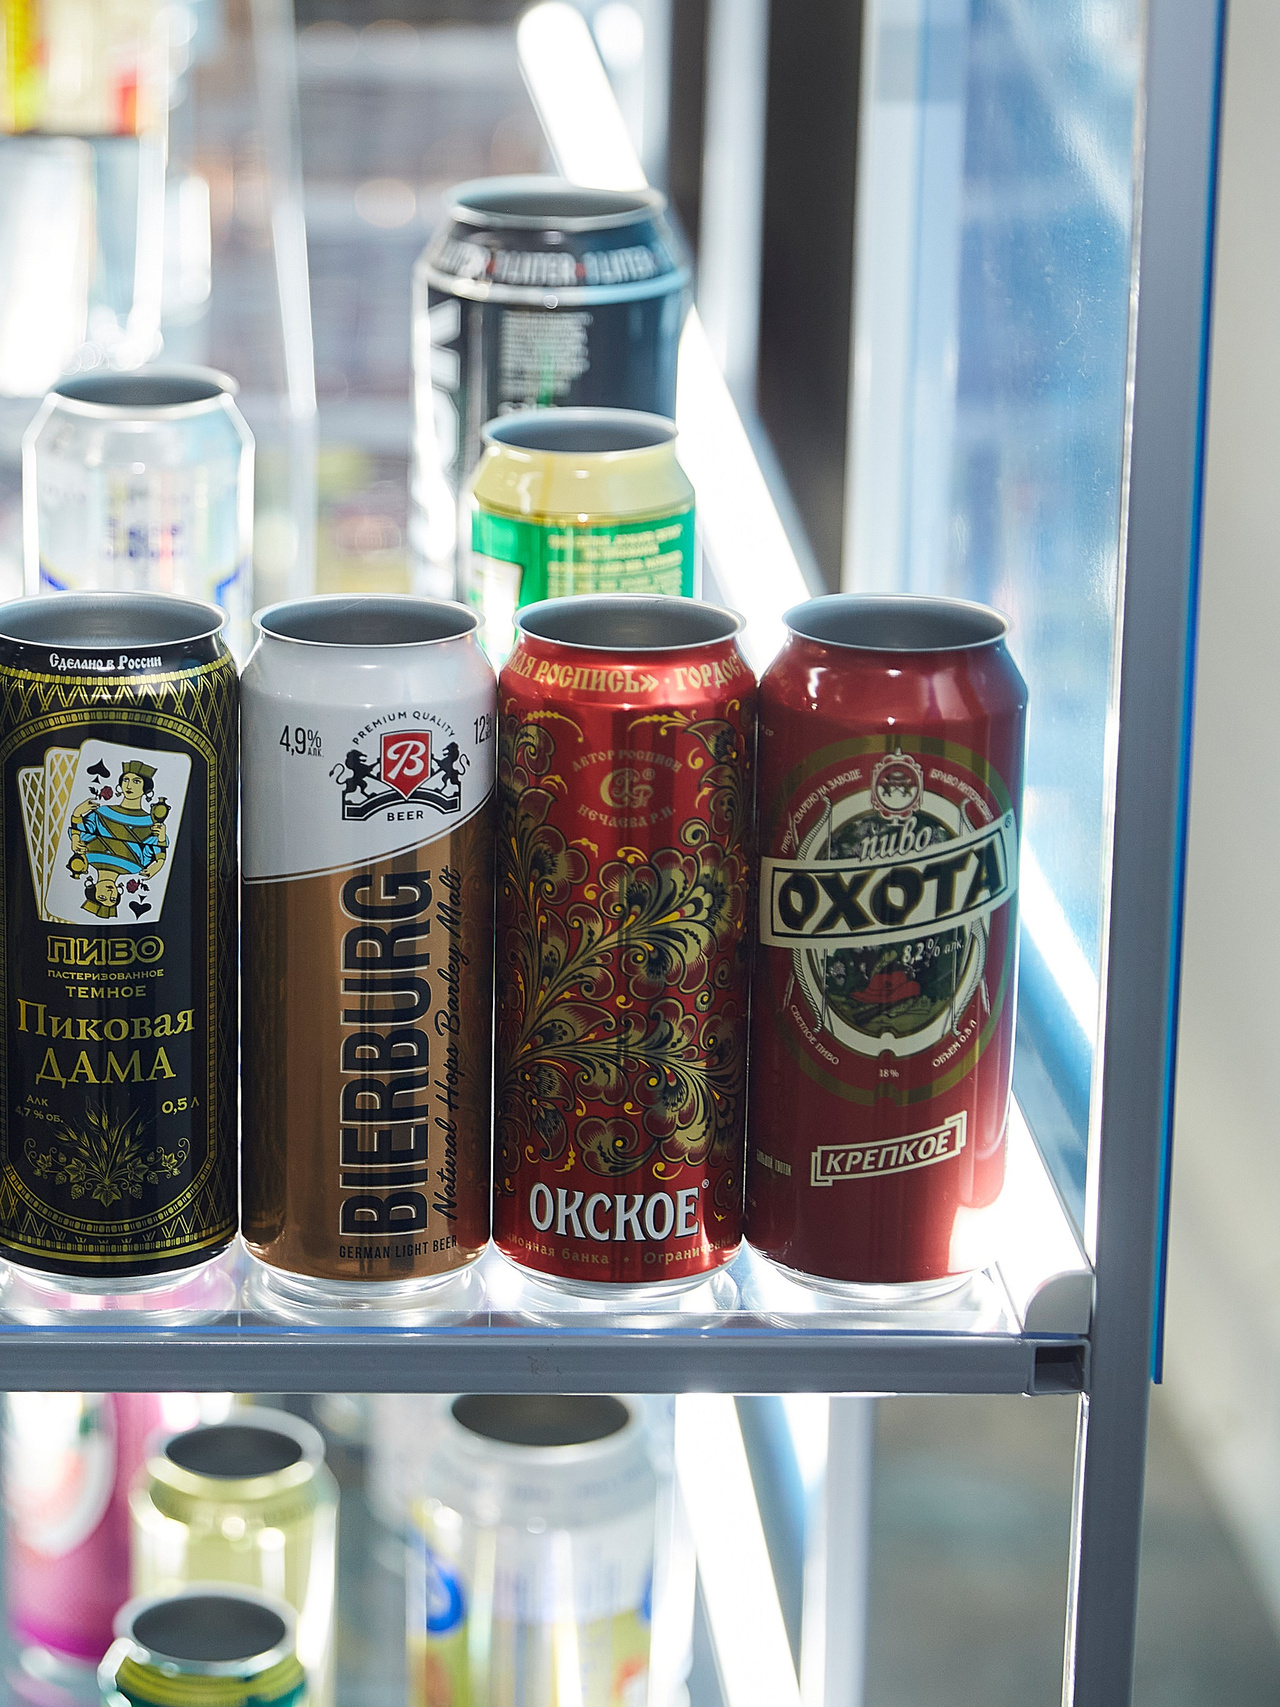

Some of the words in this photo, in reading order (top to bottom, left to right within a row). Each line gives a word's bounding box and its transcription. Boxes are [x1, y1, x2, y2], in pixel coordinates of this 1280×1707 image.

[279, 725, 322, 756] 4,9%
[352, 711, 407, 746] PREMIUM
[412, 710, 456, 738] QUALITY
[387, 740, 427, 780] B
[572, 749, 615, 772] АВТОР
[827, 768, 863, 790] ЗАВОДЕ
[387, 810, 424, 821] BEER
[859, 815, 932, 863] пиво
[435, 865, 463, 939] Malt
[778, 837, 1005, 935] ОХОТА
[46, 935, 165, 966] ПИВО
[48, 968, 165, 981] ПАСТЕРИЗОВАННОЕ
[65, 985, 147, 999] ТЕМНОЕ
[433, 951, 470, 1037] Barley
[790, 1004, 818, 1045] СВЕТЛОЕ
[815, 1042, 840, 1065] ПИВО
[35, 1046, 177, 1089] ДАМА
[338, 869, 433, 1238] BIERBURG
[932, 1041, 962, 1068] ОБЪЕМ
[26, 1094, 49, 1107] АЛК
[434, 1045, 465, 1120] Hops
[162, 1097, 188, 1115] 0,5
[825, 1130, 953, 1175] КРЕПКОЕ
[432, 1123, 459, 1221] Natural
[529, 1181, 700, 1242] ОКСКОЕ
[339, 1243, 392, 1260] GERMAN
[395, 1240, 429, 1258] LIGHT
[433, 1235, 458, 1252] BEER
[562, 1247, 610, 1265] банка
